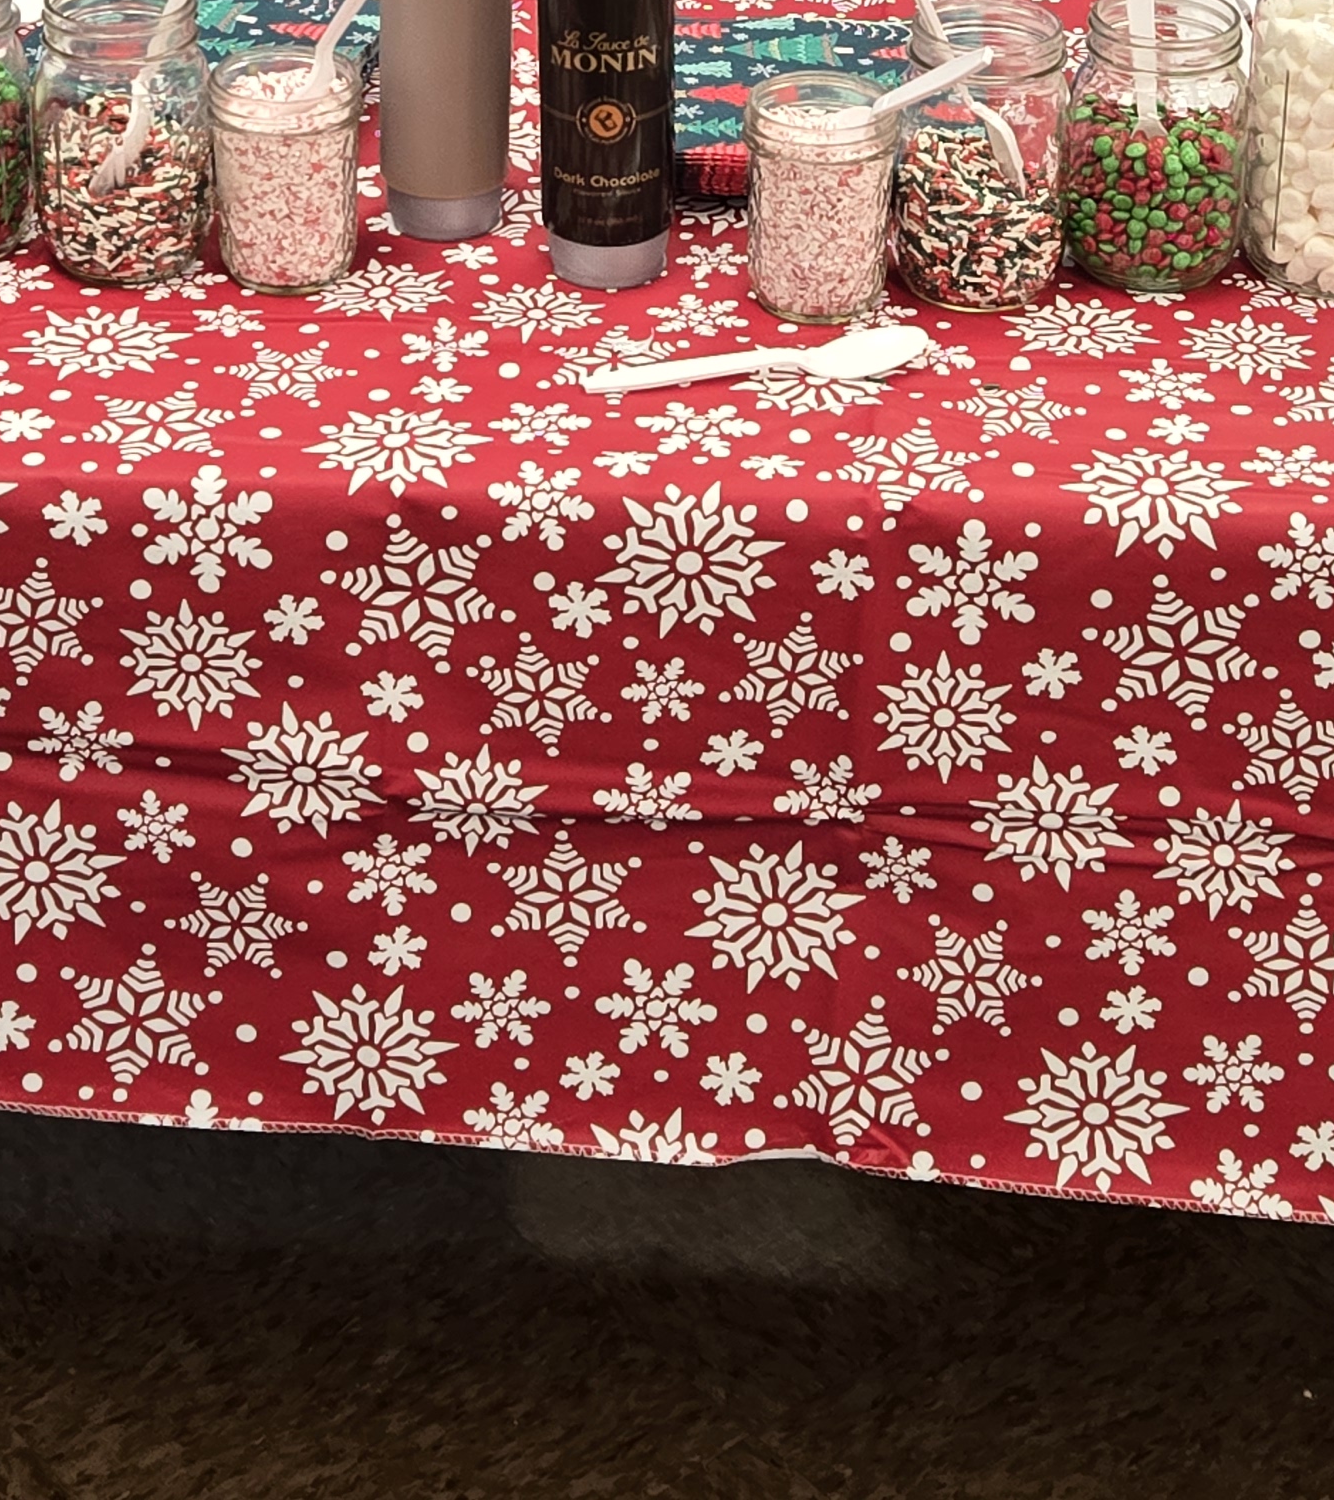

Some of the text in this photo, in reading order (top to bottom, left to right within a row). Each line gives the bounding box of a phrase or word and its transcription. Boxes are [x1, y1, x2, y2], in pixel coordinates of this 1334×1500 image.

[557, 29, 650, 51] La Sauce de
[551, 43, 658, 74] MONIN
[554, 166, 660, 188] Dark Chocolate
